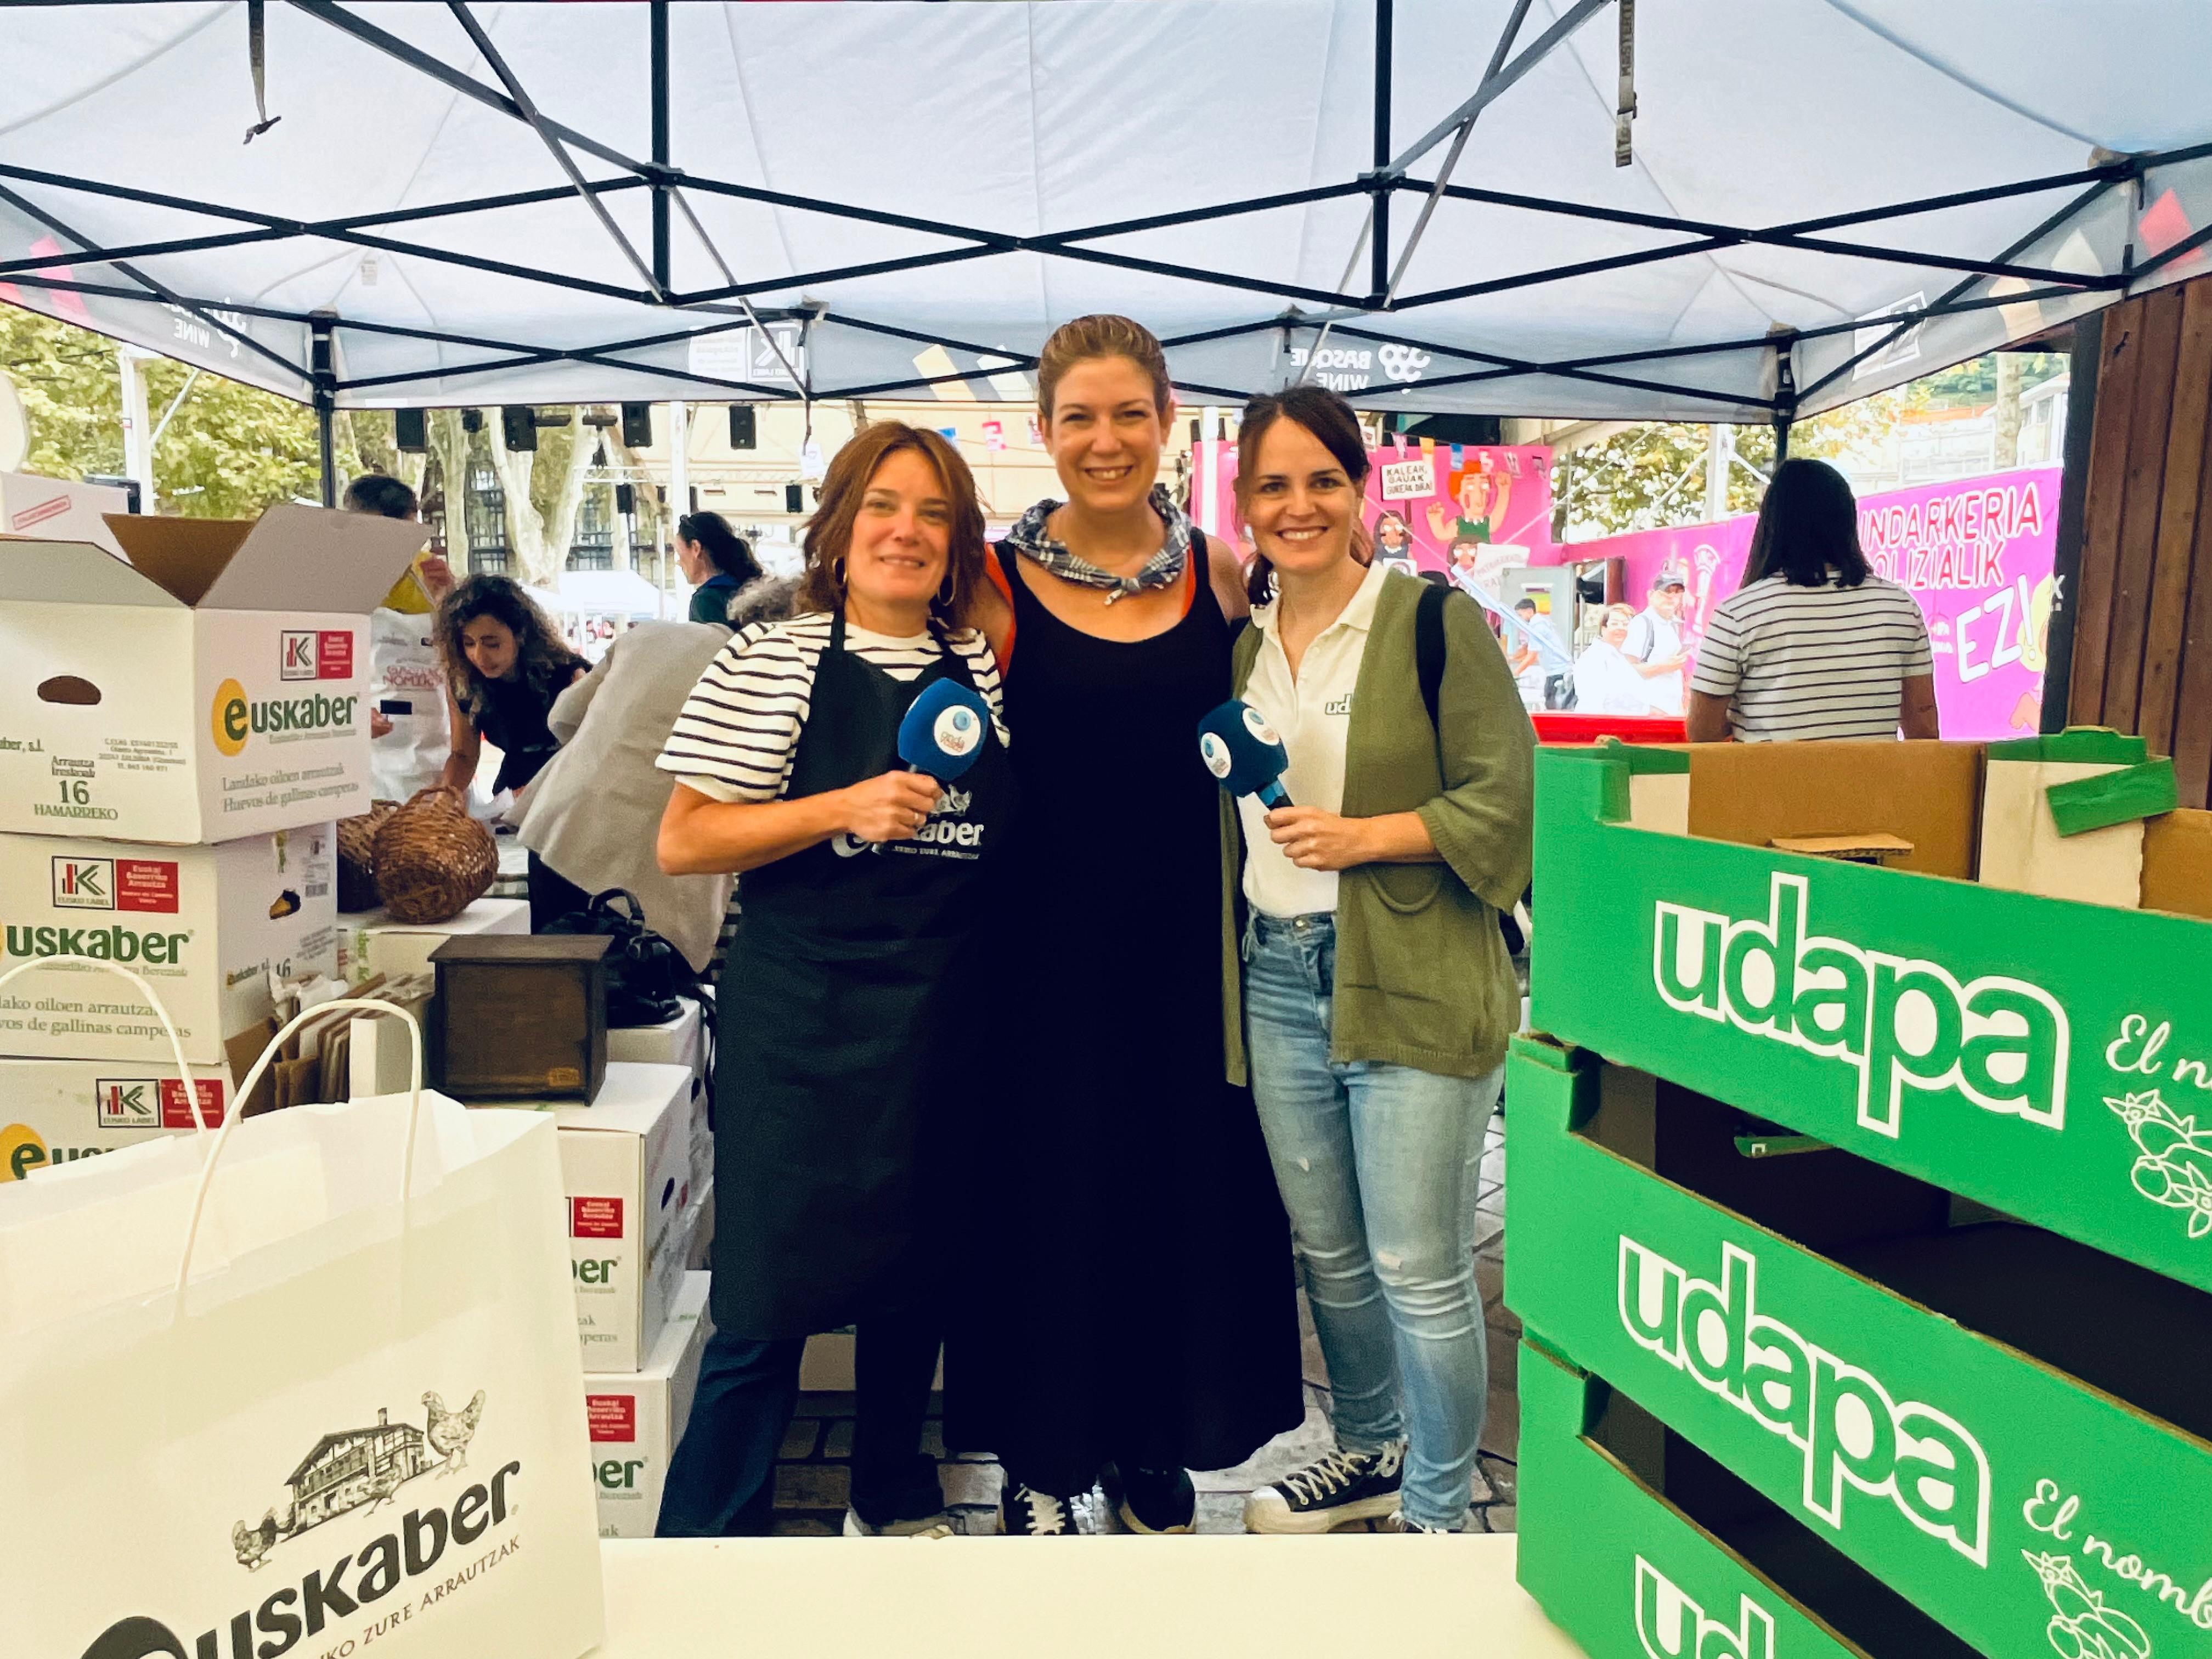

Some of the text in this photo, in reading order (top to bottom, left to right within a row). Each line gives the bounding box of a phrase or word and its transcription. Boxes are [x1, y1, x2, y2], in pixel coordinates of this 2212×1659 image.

[1955, 573, 2035, 684] EZ!
[224, 693, 358, 741] euskaber
[34, 803, 119, 820] HAMARREKO
[59, 780, 90, 805] 16
[28, 1017, 47, 1031] de
[50, 1019, 112, 1036] gallinas
[116, 1025, 191, 1041] campeas
[35, 997, 83, 1013] oiloen
[88, 1003, 159, 1017] arrautza
[1654, 871, 2070, 1138] udapa
[2105, 1014, 2171, 1074] El
[572, 1259, 618, 1284] er
[1617, 1234, 1990, 1568] udapa
[592, 1460, 644, 1489] er
[2022, 1479, 2079, 1540] El
[134, 1460, 521, 1659] uskaber
[363, 1604, 413, 1645] ZURE
[420, 1534, 521, 1612] ARRAUTZAK
